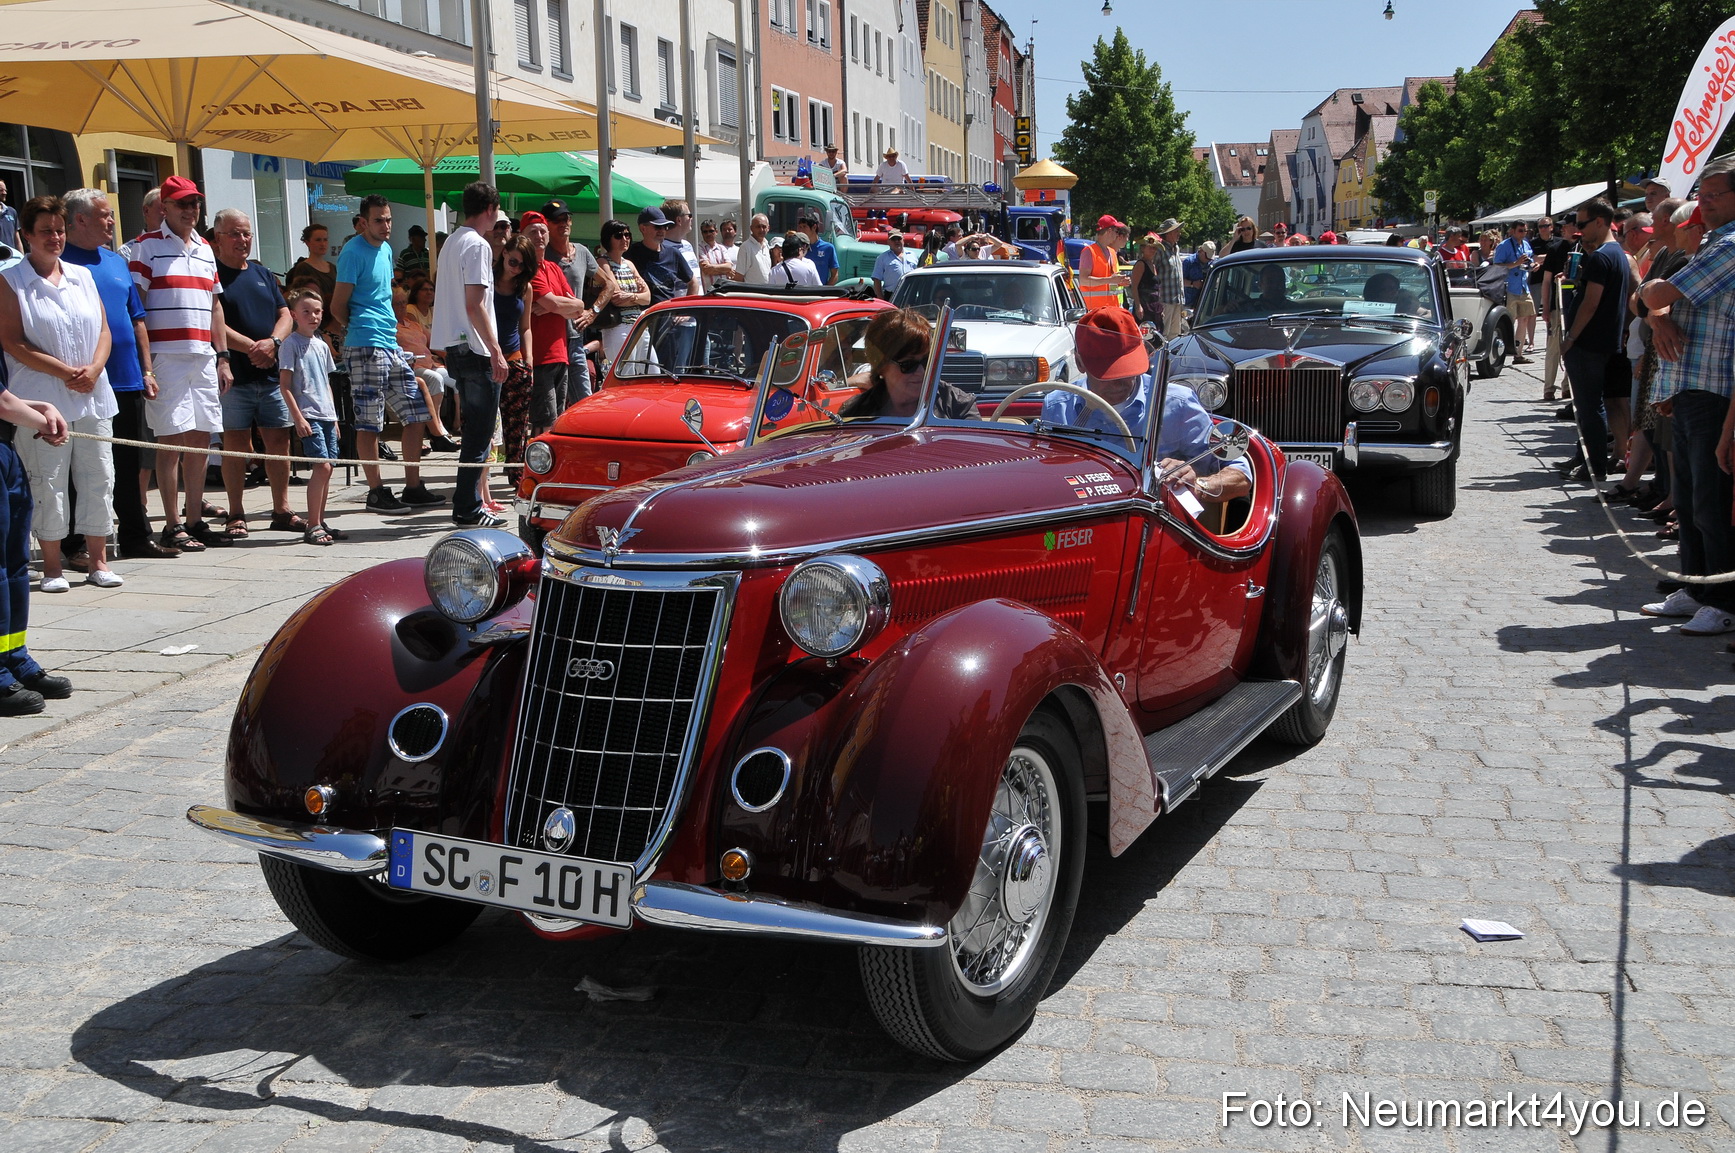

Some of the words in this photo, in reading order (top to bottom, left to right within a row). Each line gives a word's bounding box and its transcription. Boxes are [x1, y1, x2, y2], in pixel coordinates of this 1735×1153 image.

[1075, 475, 1088, 484] U.
[1085, 472, 1114, 483] FESER
[1085, 487, 1097, 497] P.
[1094, 484, 1122, 496] FESER
[1056, 528, 1094, 550] FESER
[397, 864, 405, 878] D
[423, 842, 471, 891] SC
